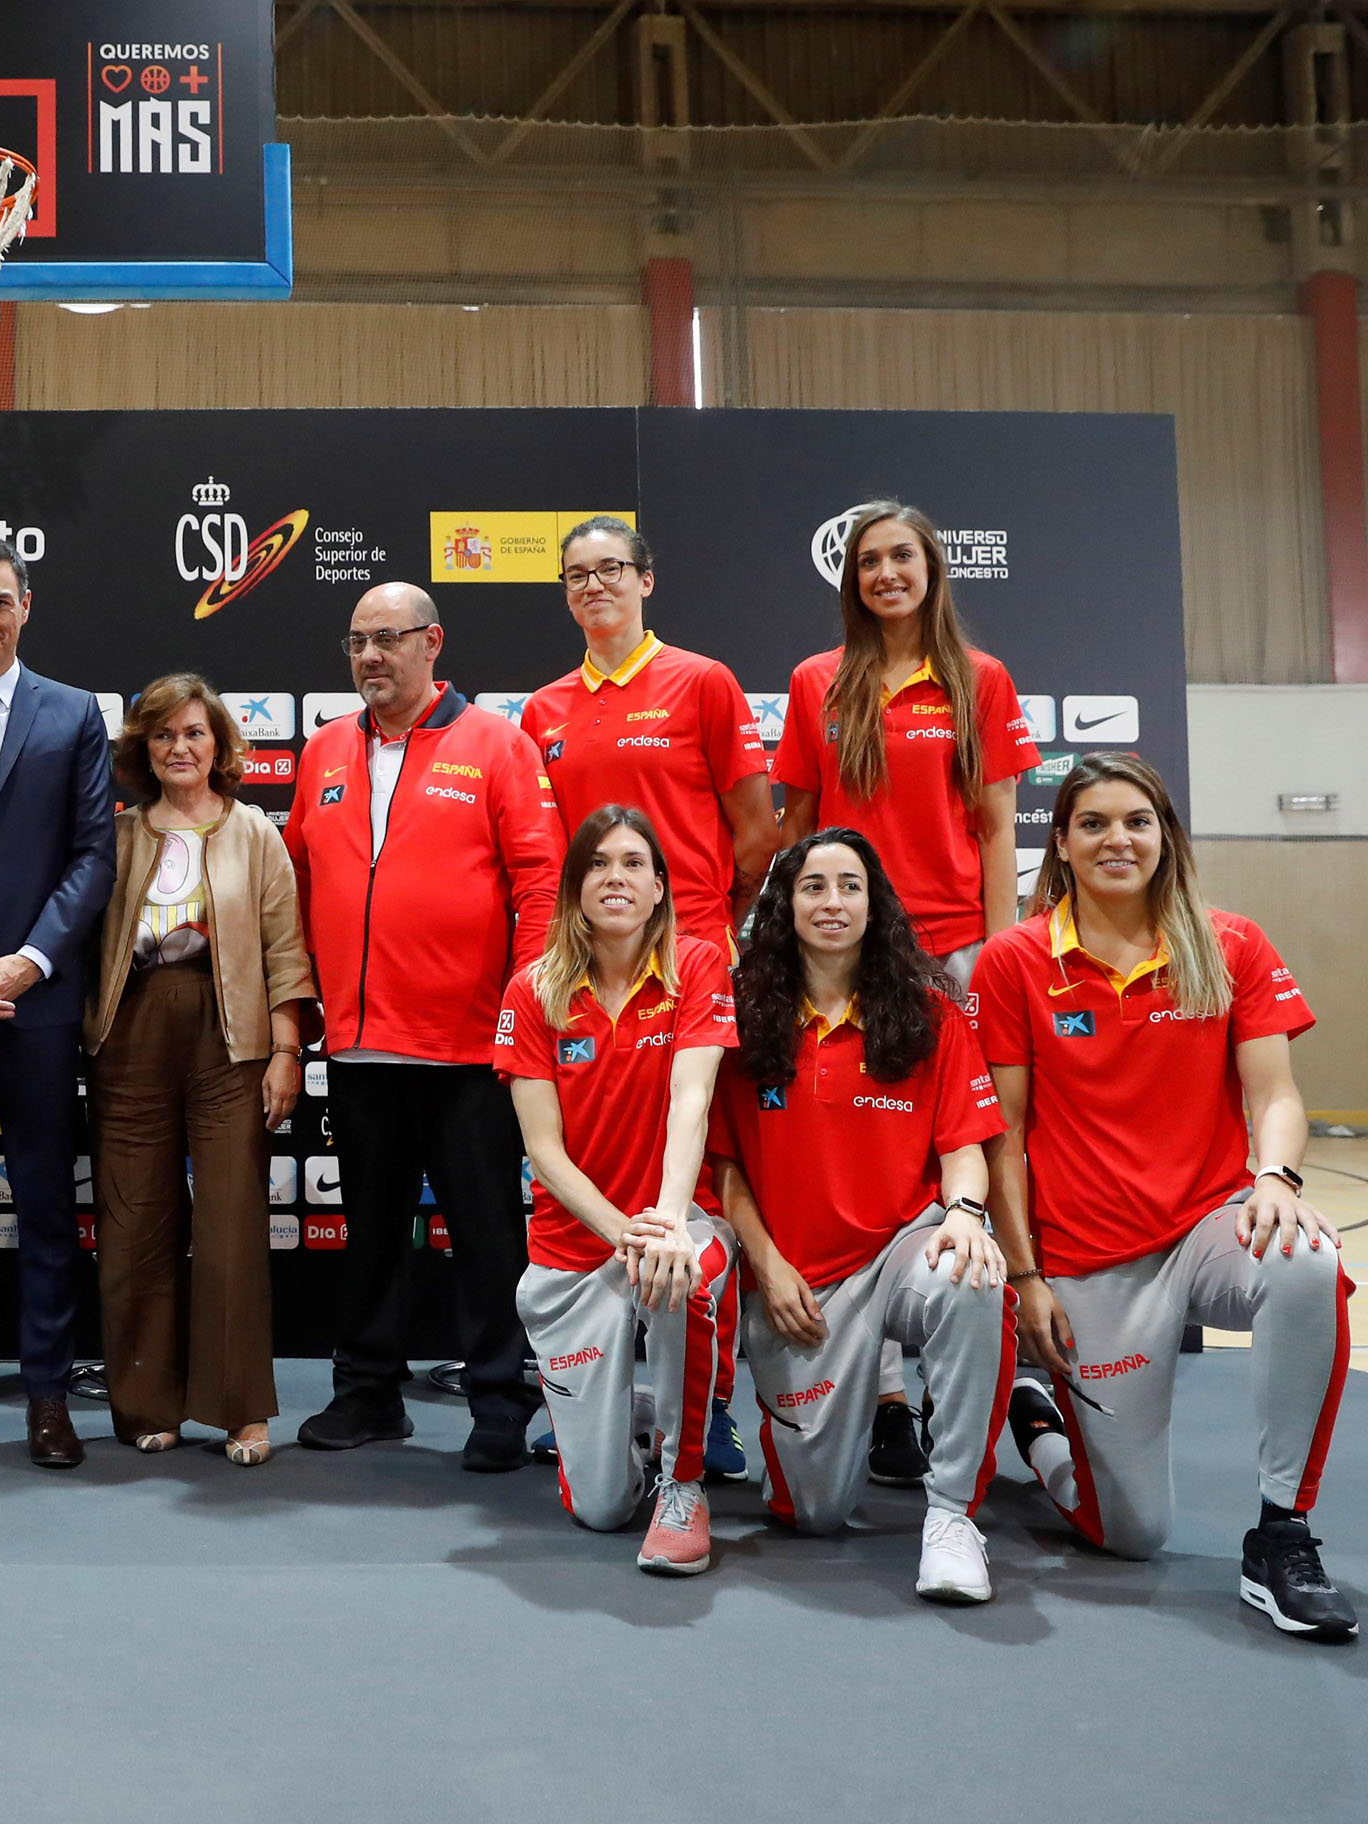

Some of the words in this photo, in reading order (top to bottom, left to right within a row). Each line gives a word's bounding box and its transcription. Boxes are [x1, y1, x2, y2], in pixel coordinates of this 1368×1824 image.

[100, 43, 210, 60] QUEREMOS
[315, 527, 363, 547] Consejo
[500, 537, 547, 545] GOBIERNO
[936, 530, 1008, 545] NIVERSO
[175, 513, 249, 582] CSD
[315, 547, 367, 565] Superior
[371, 547, 386, 562] de
[514, 545, 546, 554] ESPAÑA
[945, 546, 1009, 565] UJER
[315, 565, 371, 584] Deportes
[626, 708, 670, 722] ESPAÑA
[912, 703, 953, 715] ESPAÑ
[241, 727, 281, 737] ixaBank
[617, 735, 670, 748] endesa
[432, 762, 483, 779] ESPAÑA
[425, 786, 476, 804] endesa
[1275, 987, 1301, 1002] IBER
[713, 1014, 737, 1024] IBER
[853, 1095, 913, 1113] endesa
[976, 1095, 998, 1109] IBER
[549, 1346, 604, 1371] ESPAÑA
[1079, 1353, 1150, 1379] ESPAÑA
[776, 1379, 835, 1408] ESPAÑA
